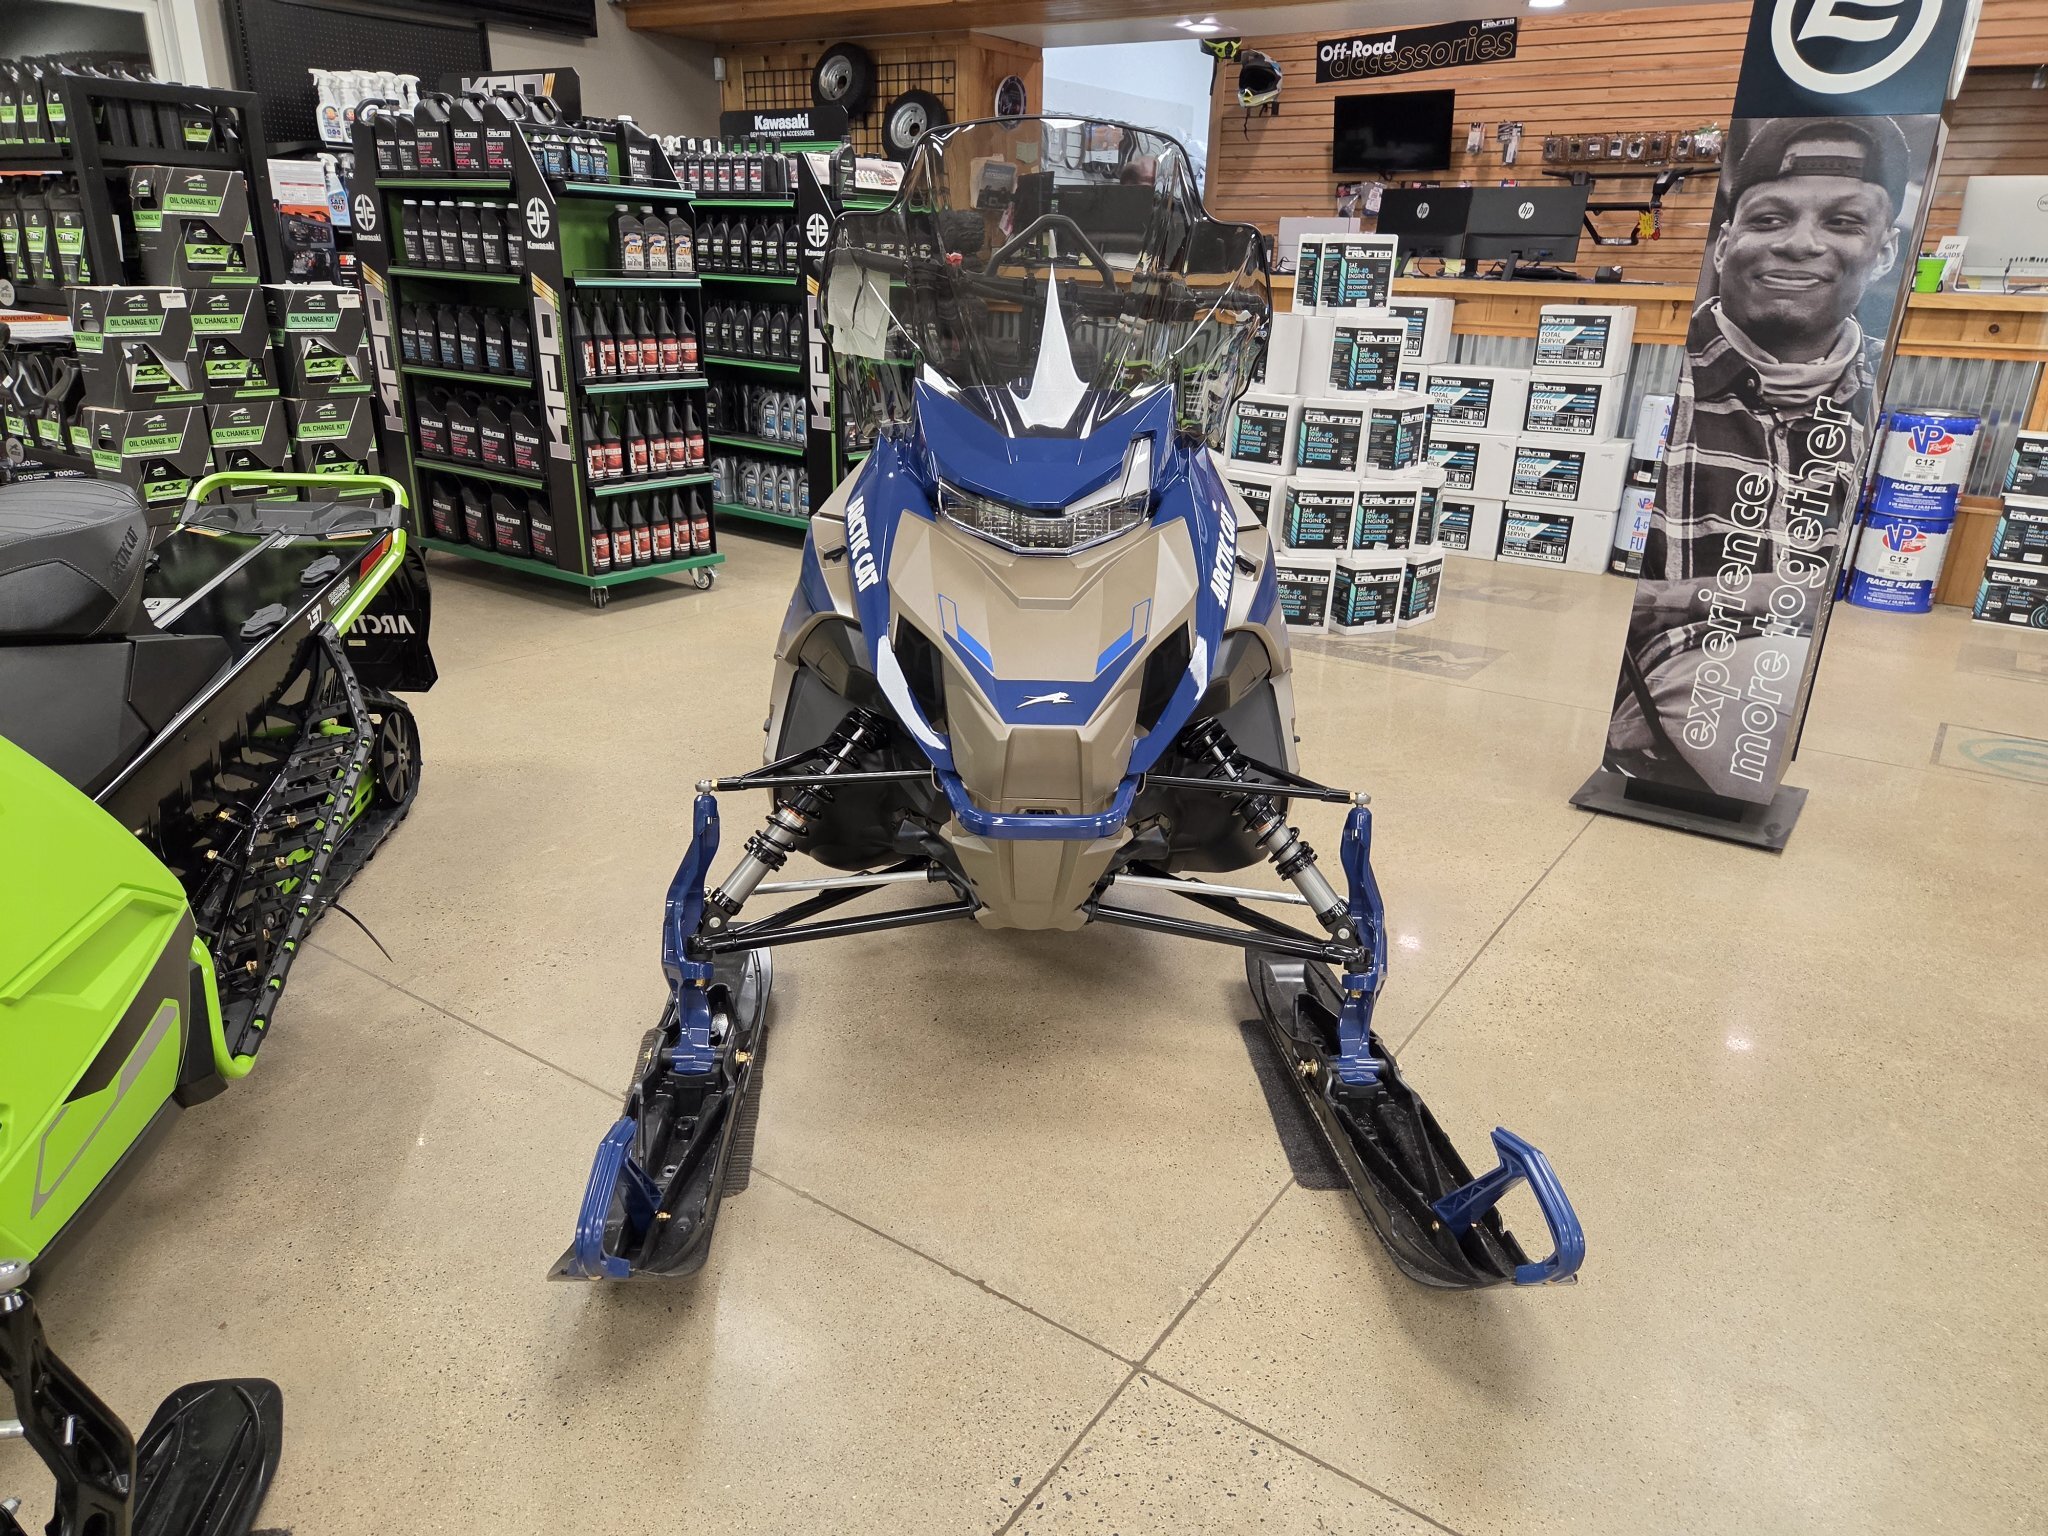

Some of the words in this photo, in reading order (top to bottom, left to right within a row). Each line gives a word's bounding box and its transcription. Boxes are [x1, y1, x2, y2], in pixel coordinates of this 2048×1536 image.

[1321, 35, 1396, 62] Off-Road
[1330, 26, 1514, 78] accessories
[754, 113, 808, 130] Kawasaki
[182, 197, 206, 205] CHANGE
[1417, 202, 1430, 219] hp
[1518, 202, 1535, 220] hp
[357, 233, 381, 241] Kawasaki
[527, 241, 555, 250] Kawasaki
[212, 362, 241, 370] ACX
[309, 360, 336, 368] ACX
[1239, 408, 1287, 418] CRAFTED
[1305, 415, 1360, 425] CRAFTED
[141, 438, 165, 446] CHANGE
[1911, 425, 1945, 454] VP
[323, 465, 349, 473] ACX
[152, 482, 182, 492] ACX
[1239, 488, 1269, 498] AFTED
[1891, 482, 1921, 492] RACE
[1922, 485, 1947, 493] FUEL
[1220, 501, 1235, 543] CAT
[1753, 396, 1852, 638] together
[847, 496, 870, 559] ARCTIC
[125, 526, 138, 549] CAT
[1630, 537, 1643, 550] FU
[1885, 524, 1918, 551] VP
[855, 553, 879, 592] CAT
[1210, 531, 1234, 609] ARCTIC
[1417, 565, 1441, 576] CRAFTED
[1355, 574, 1399, 583] CRAFTED
[1866, 577, 1893, 587] RACE
[1992, 575, 2038, 586] CRAFTED
[307, 604, 321, 630] 137
[1682, 472, 1774, 749] experience
[1729, 650, 1790, 782] more
